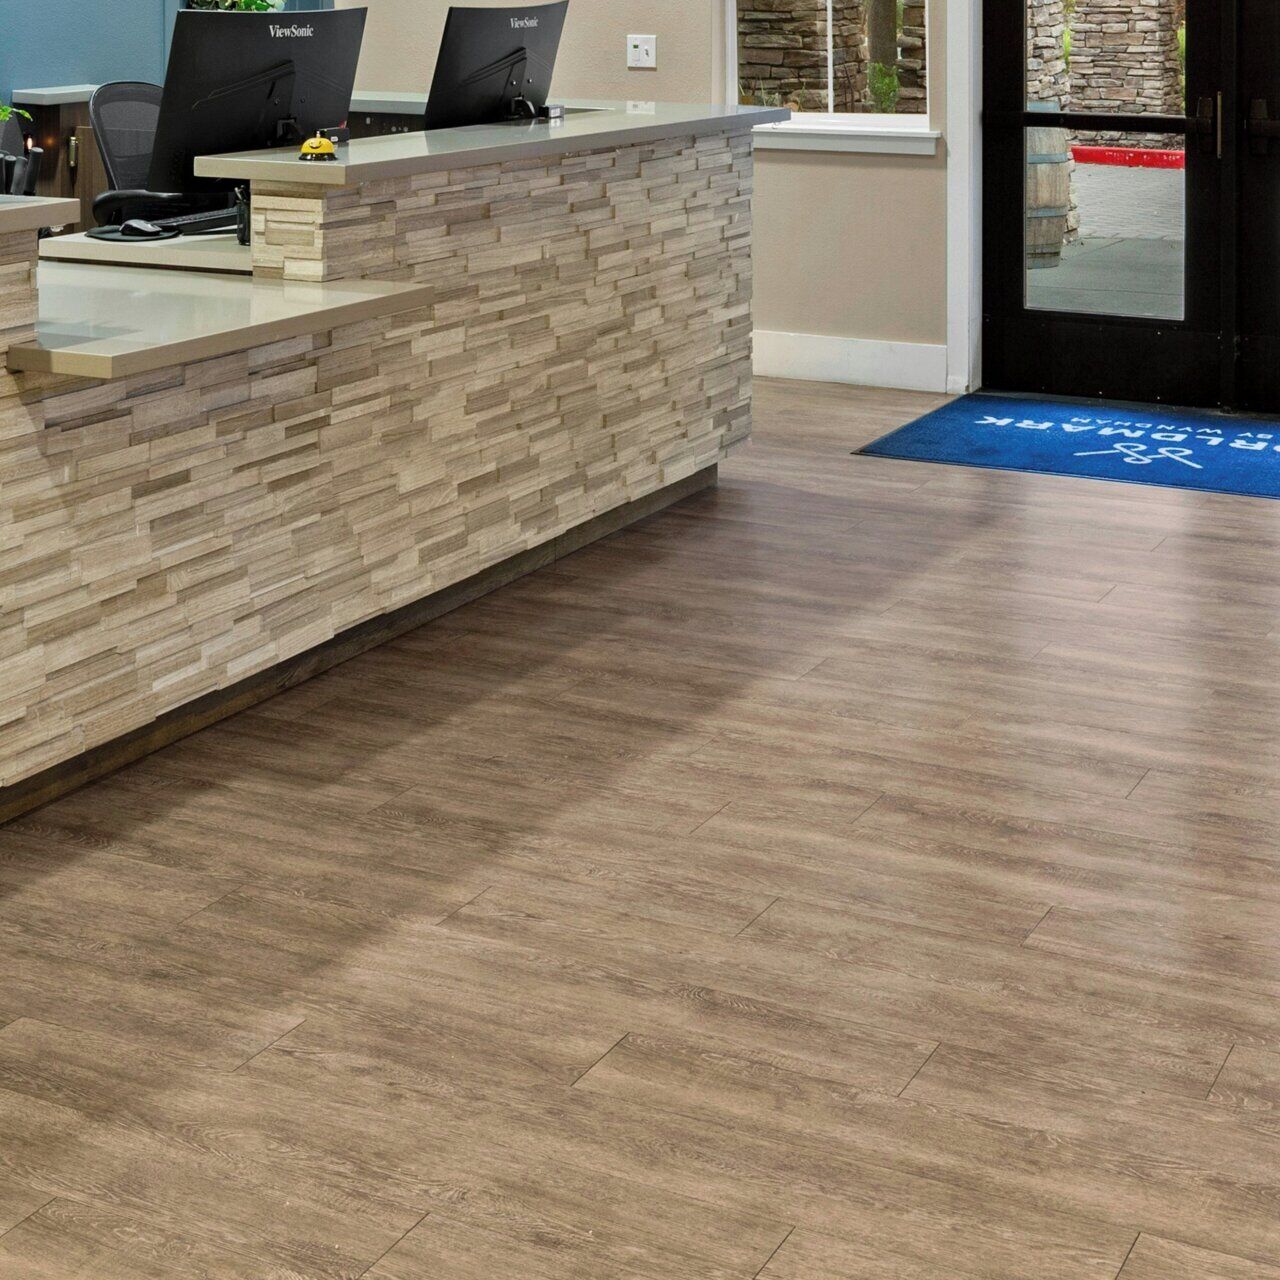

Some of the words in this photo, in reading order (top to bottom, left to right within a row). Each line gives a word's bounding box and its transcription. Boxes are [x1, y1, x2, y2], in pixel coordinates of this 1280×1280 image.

[269, 24, 314, 38] ViewSonic
[1071, 417, 1223, 435] WYNDHAM
[1237, 432, 1274, 440] BY
